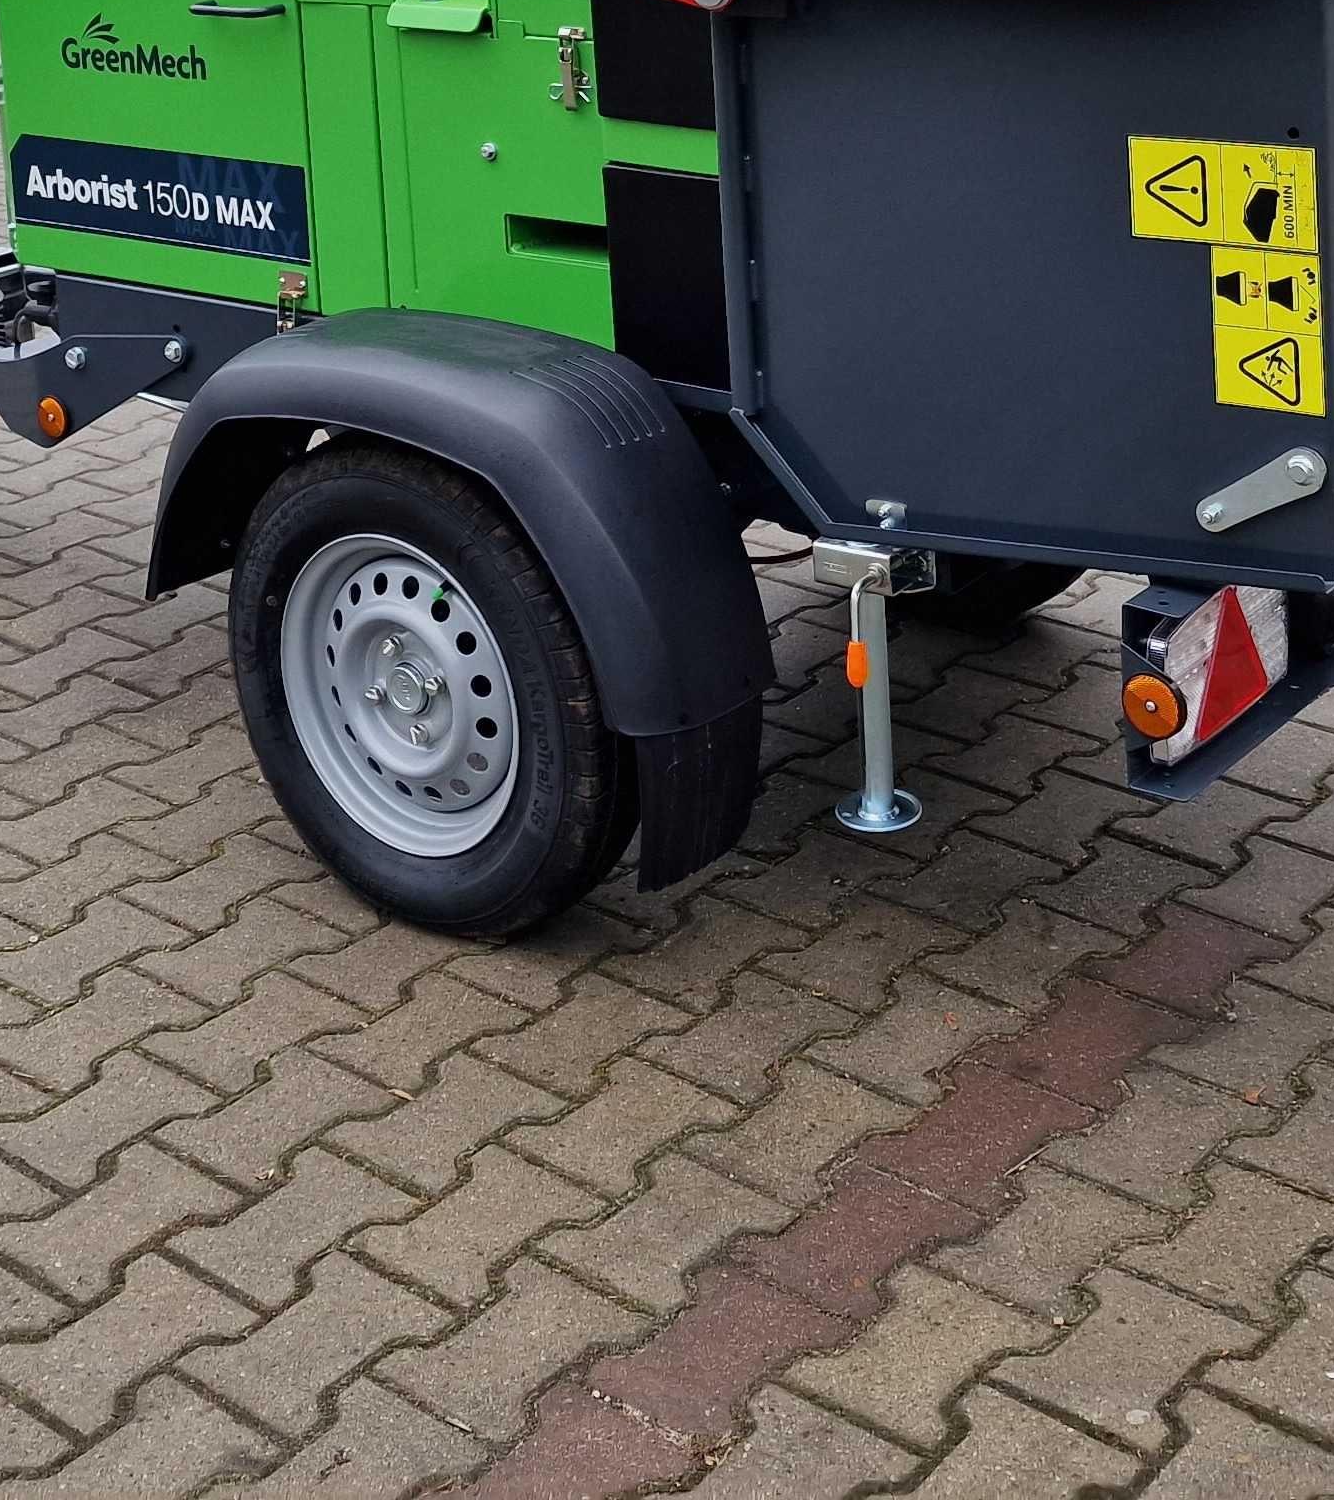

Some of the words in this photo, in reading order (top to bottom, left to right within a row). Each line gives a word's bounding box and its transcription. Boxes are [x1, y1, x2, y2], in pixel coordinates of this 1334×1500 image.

[61, 37, 208, 81] GreenMech
[26, 164, 139, 211] Arborist
[214, 194, 276, 232] MAX
[1282, 185, 1294, 212] MIN
[1283, 215, 1295, 239] 600
